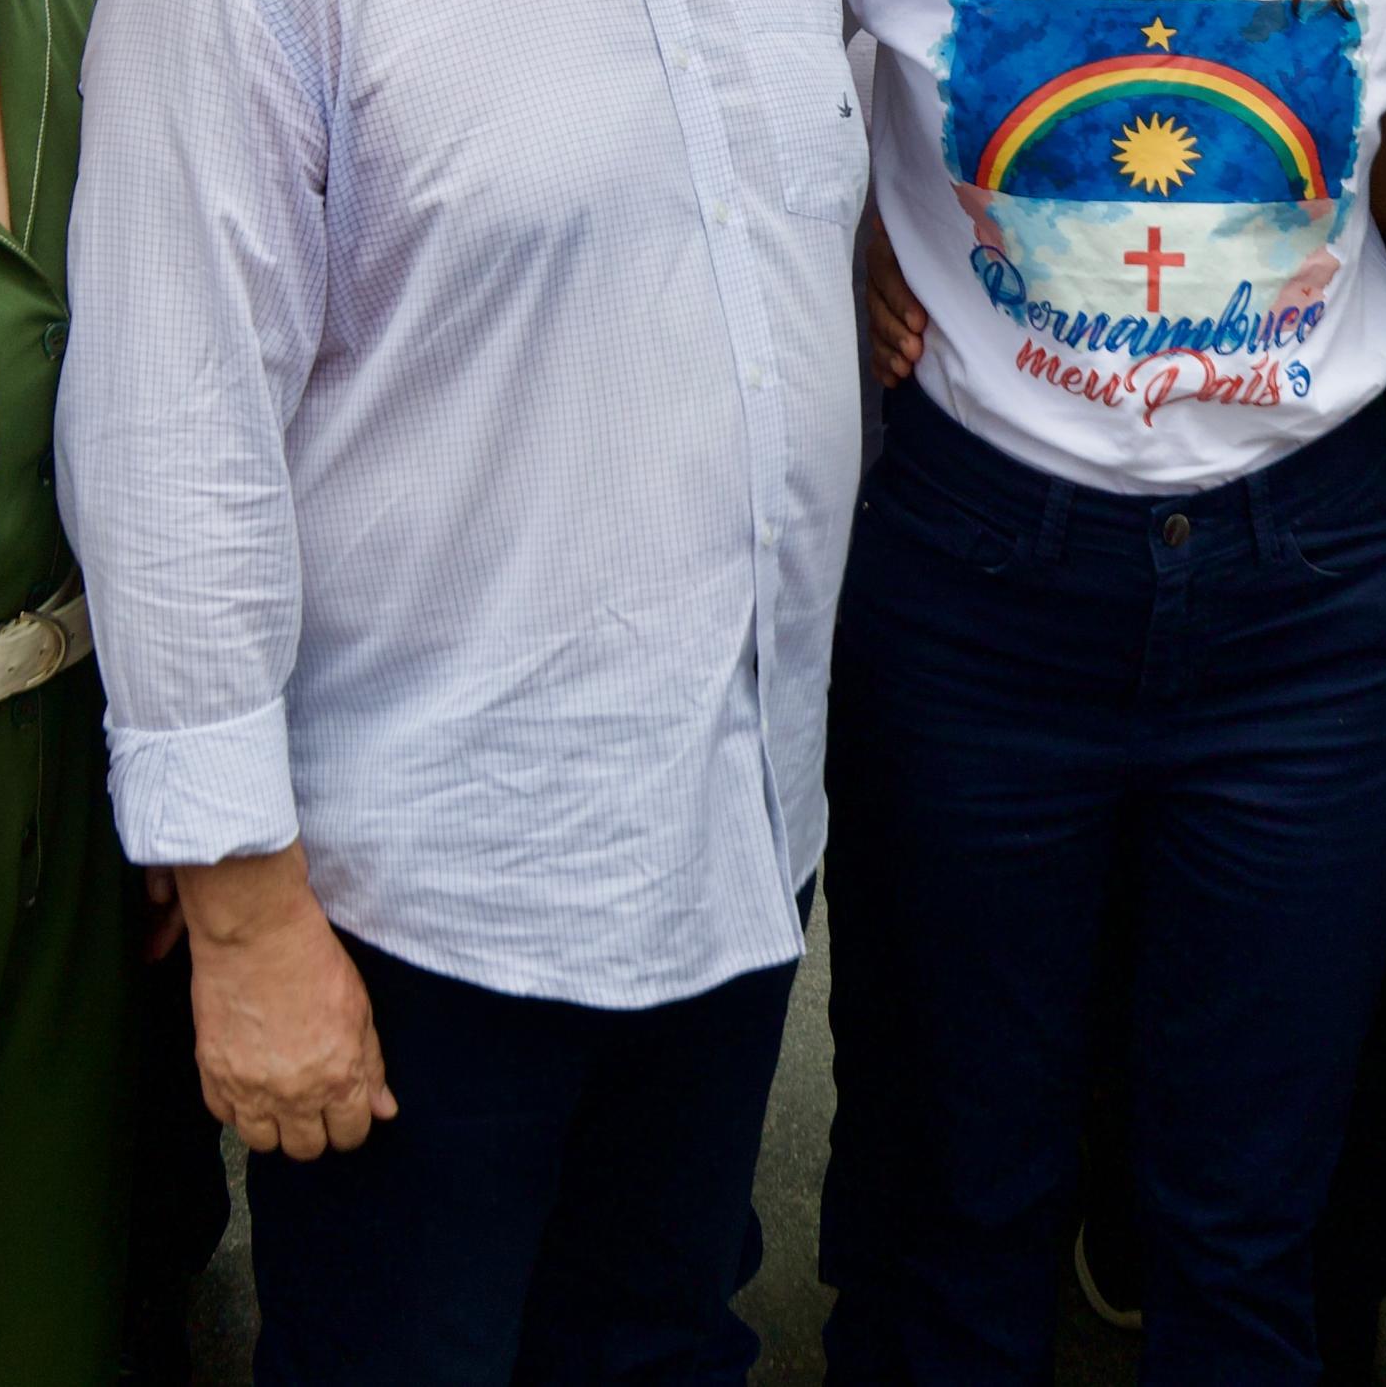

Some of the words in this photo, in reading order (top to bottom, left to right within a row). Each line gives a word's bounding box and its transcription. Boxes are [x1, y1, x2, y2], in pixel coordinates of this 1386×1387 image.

[969, 244, 1326, 357] Pernambuco
[1015, 338, 1123, 407] meu
[1124, 347, 1282, 427] País
